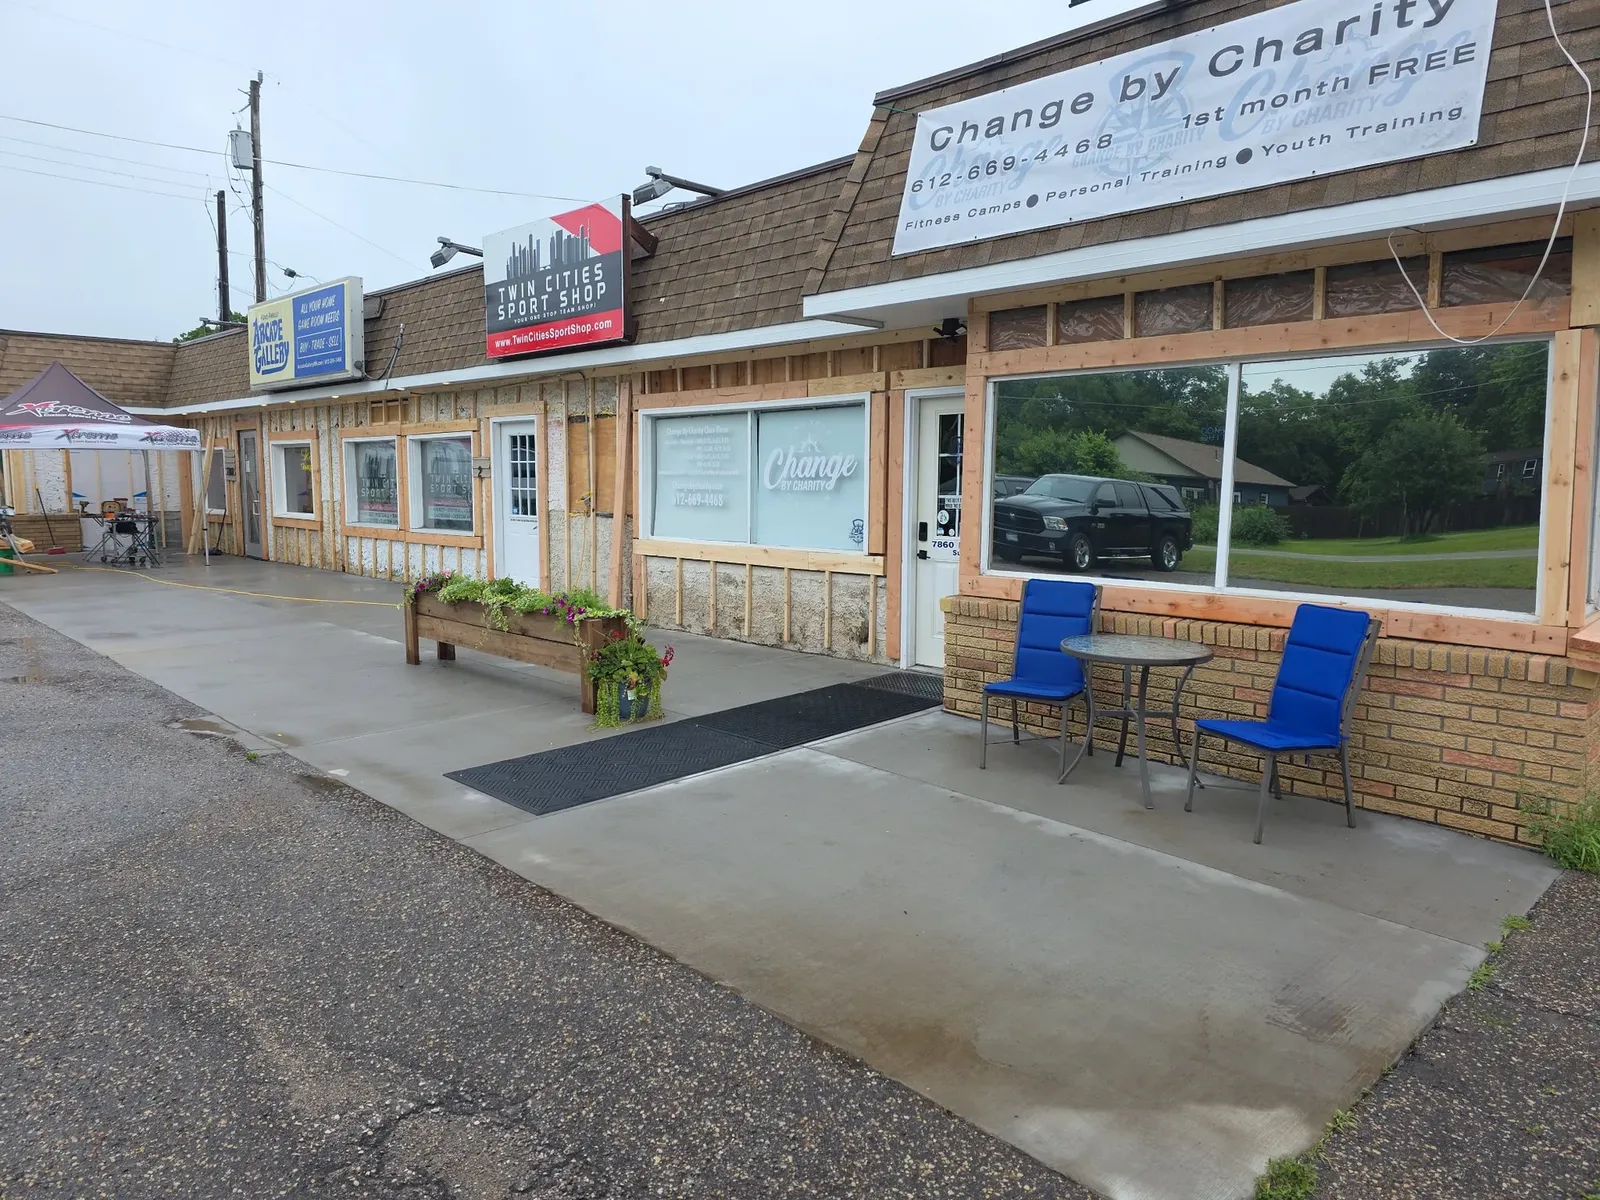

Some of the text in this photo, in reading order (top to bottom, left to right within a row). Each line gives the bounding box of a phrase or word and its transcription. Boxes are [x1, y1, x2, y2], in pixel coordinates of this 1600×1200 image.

[930, 0, 1456, 152] Change by Charity
[911, 42, 1476, 193] 612-669-4468 1st month FREE
[905, 106, 1463, 231] Fitness Camps Personal Training Youth Training
[498, 262, 602, 303] TWIN CITIES
[300, 302, 308, 314] ALL
[498, 282, 606, 320] SPORT SHOP
[253, 316, 283, 347] ARCADE
[298, 317, 310, 330] GAME
[324, 310, 340, 324] NEEDS
[530, 313, 541, 321] ONE
[311, 338, 324, 351] TRADE
[328, 334, 339, 347] SELL
[495, 319, 612, 349] www.TwinCitiesSportShop.com
[254, 341, 289, 374] GALLERY
[383, 478, 396, 488] CIT
[763, 447, 858, 490] Change
[361, 488, 385, 498] SPORT
[430, 484, 456, 493] SPORT
[781, 480, 825, 491] BY CHARITY
